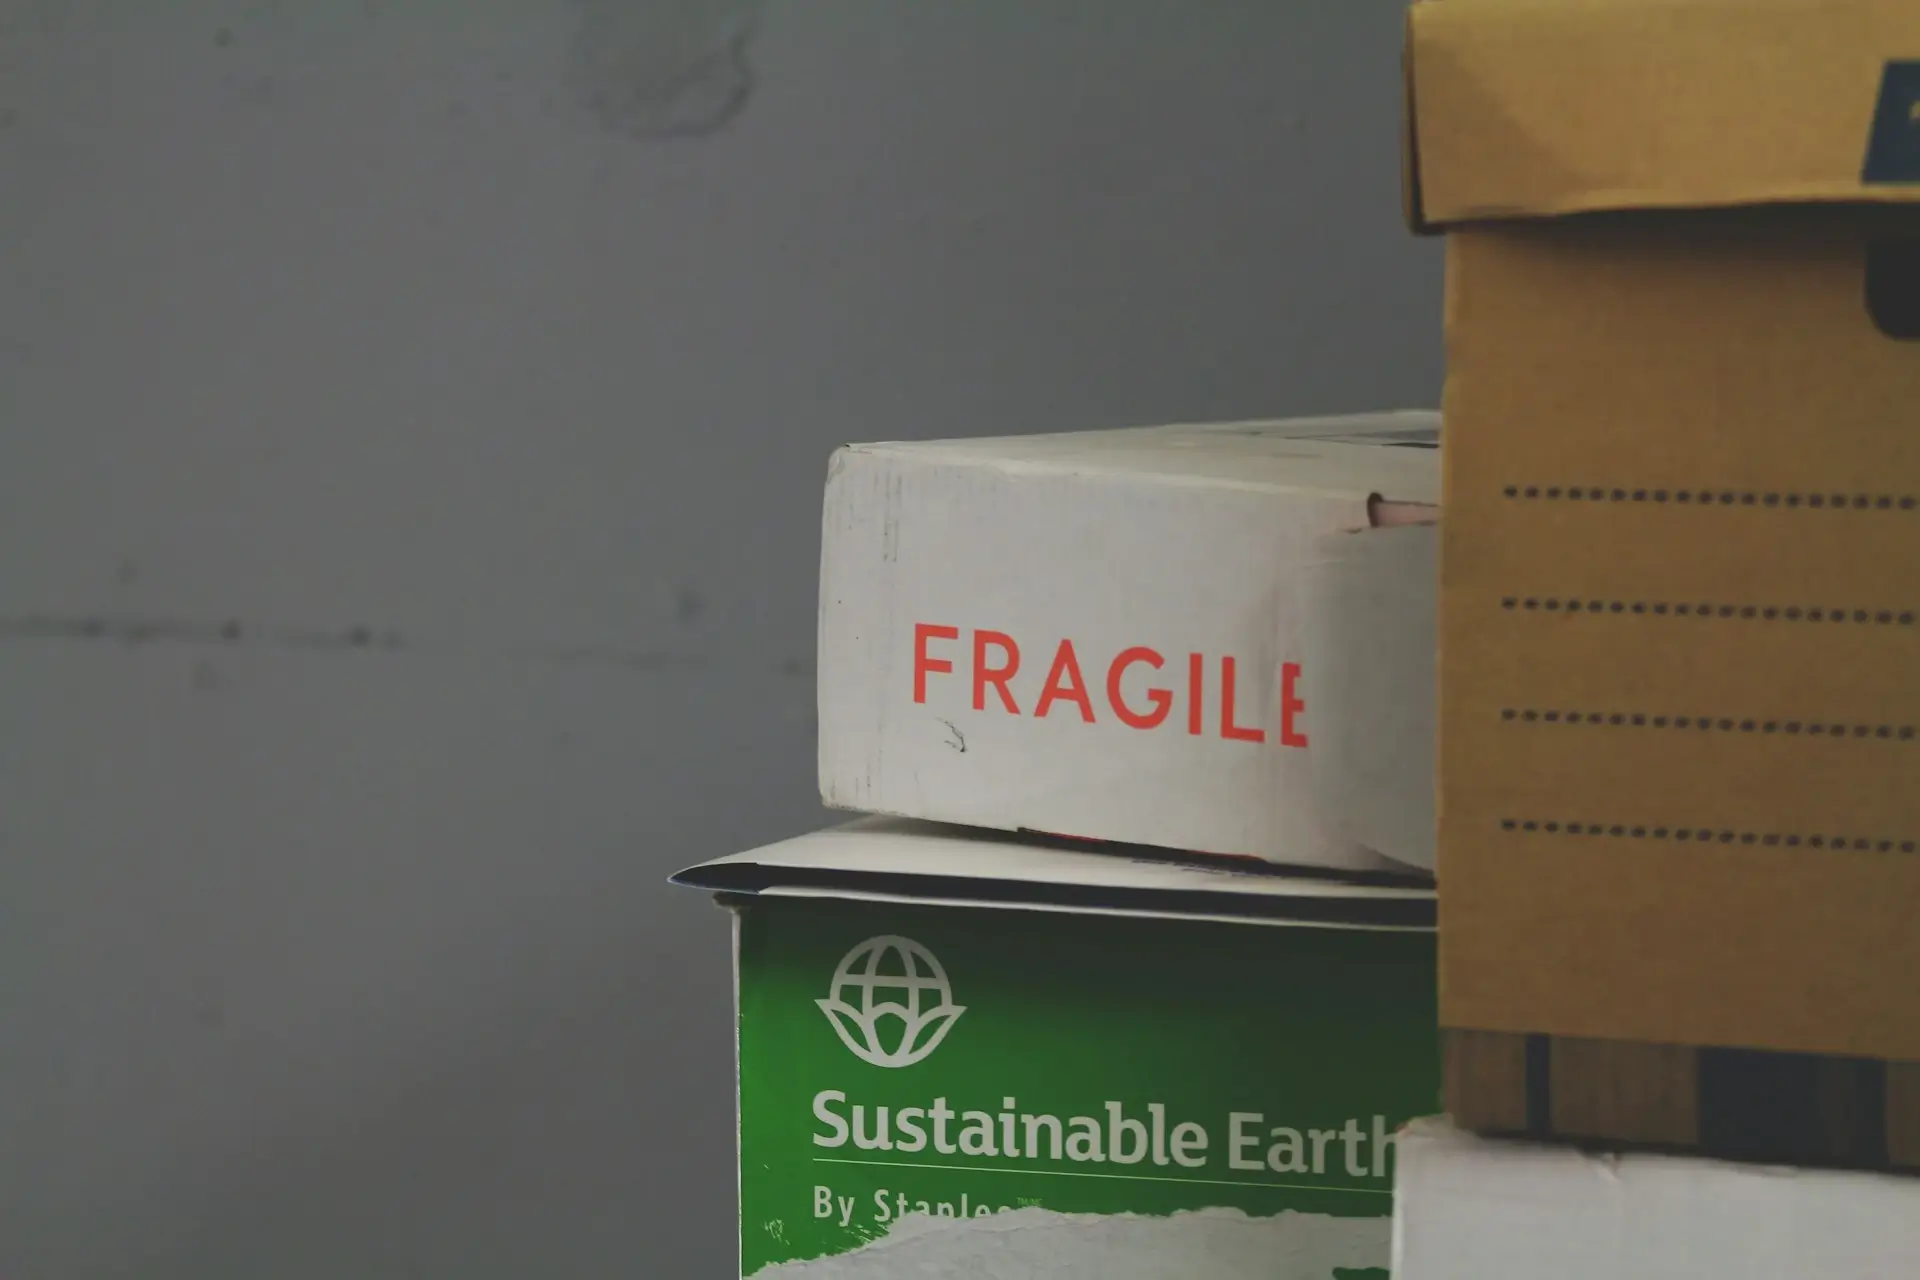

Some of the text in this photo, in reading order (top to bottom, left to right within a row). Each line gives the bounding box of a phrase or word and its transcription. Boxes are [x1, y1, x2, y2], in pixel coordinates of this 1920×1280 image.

[913, 622, 1309, 748] FRAGILE
[812, 1090, 1208, 1167] Sustainable
[813, 1185, 855, 1227] By
